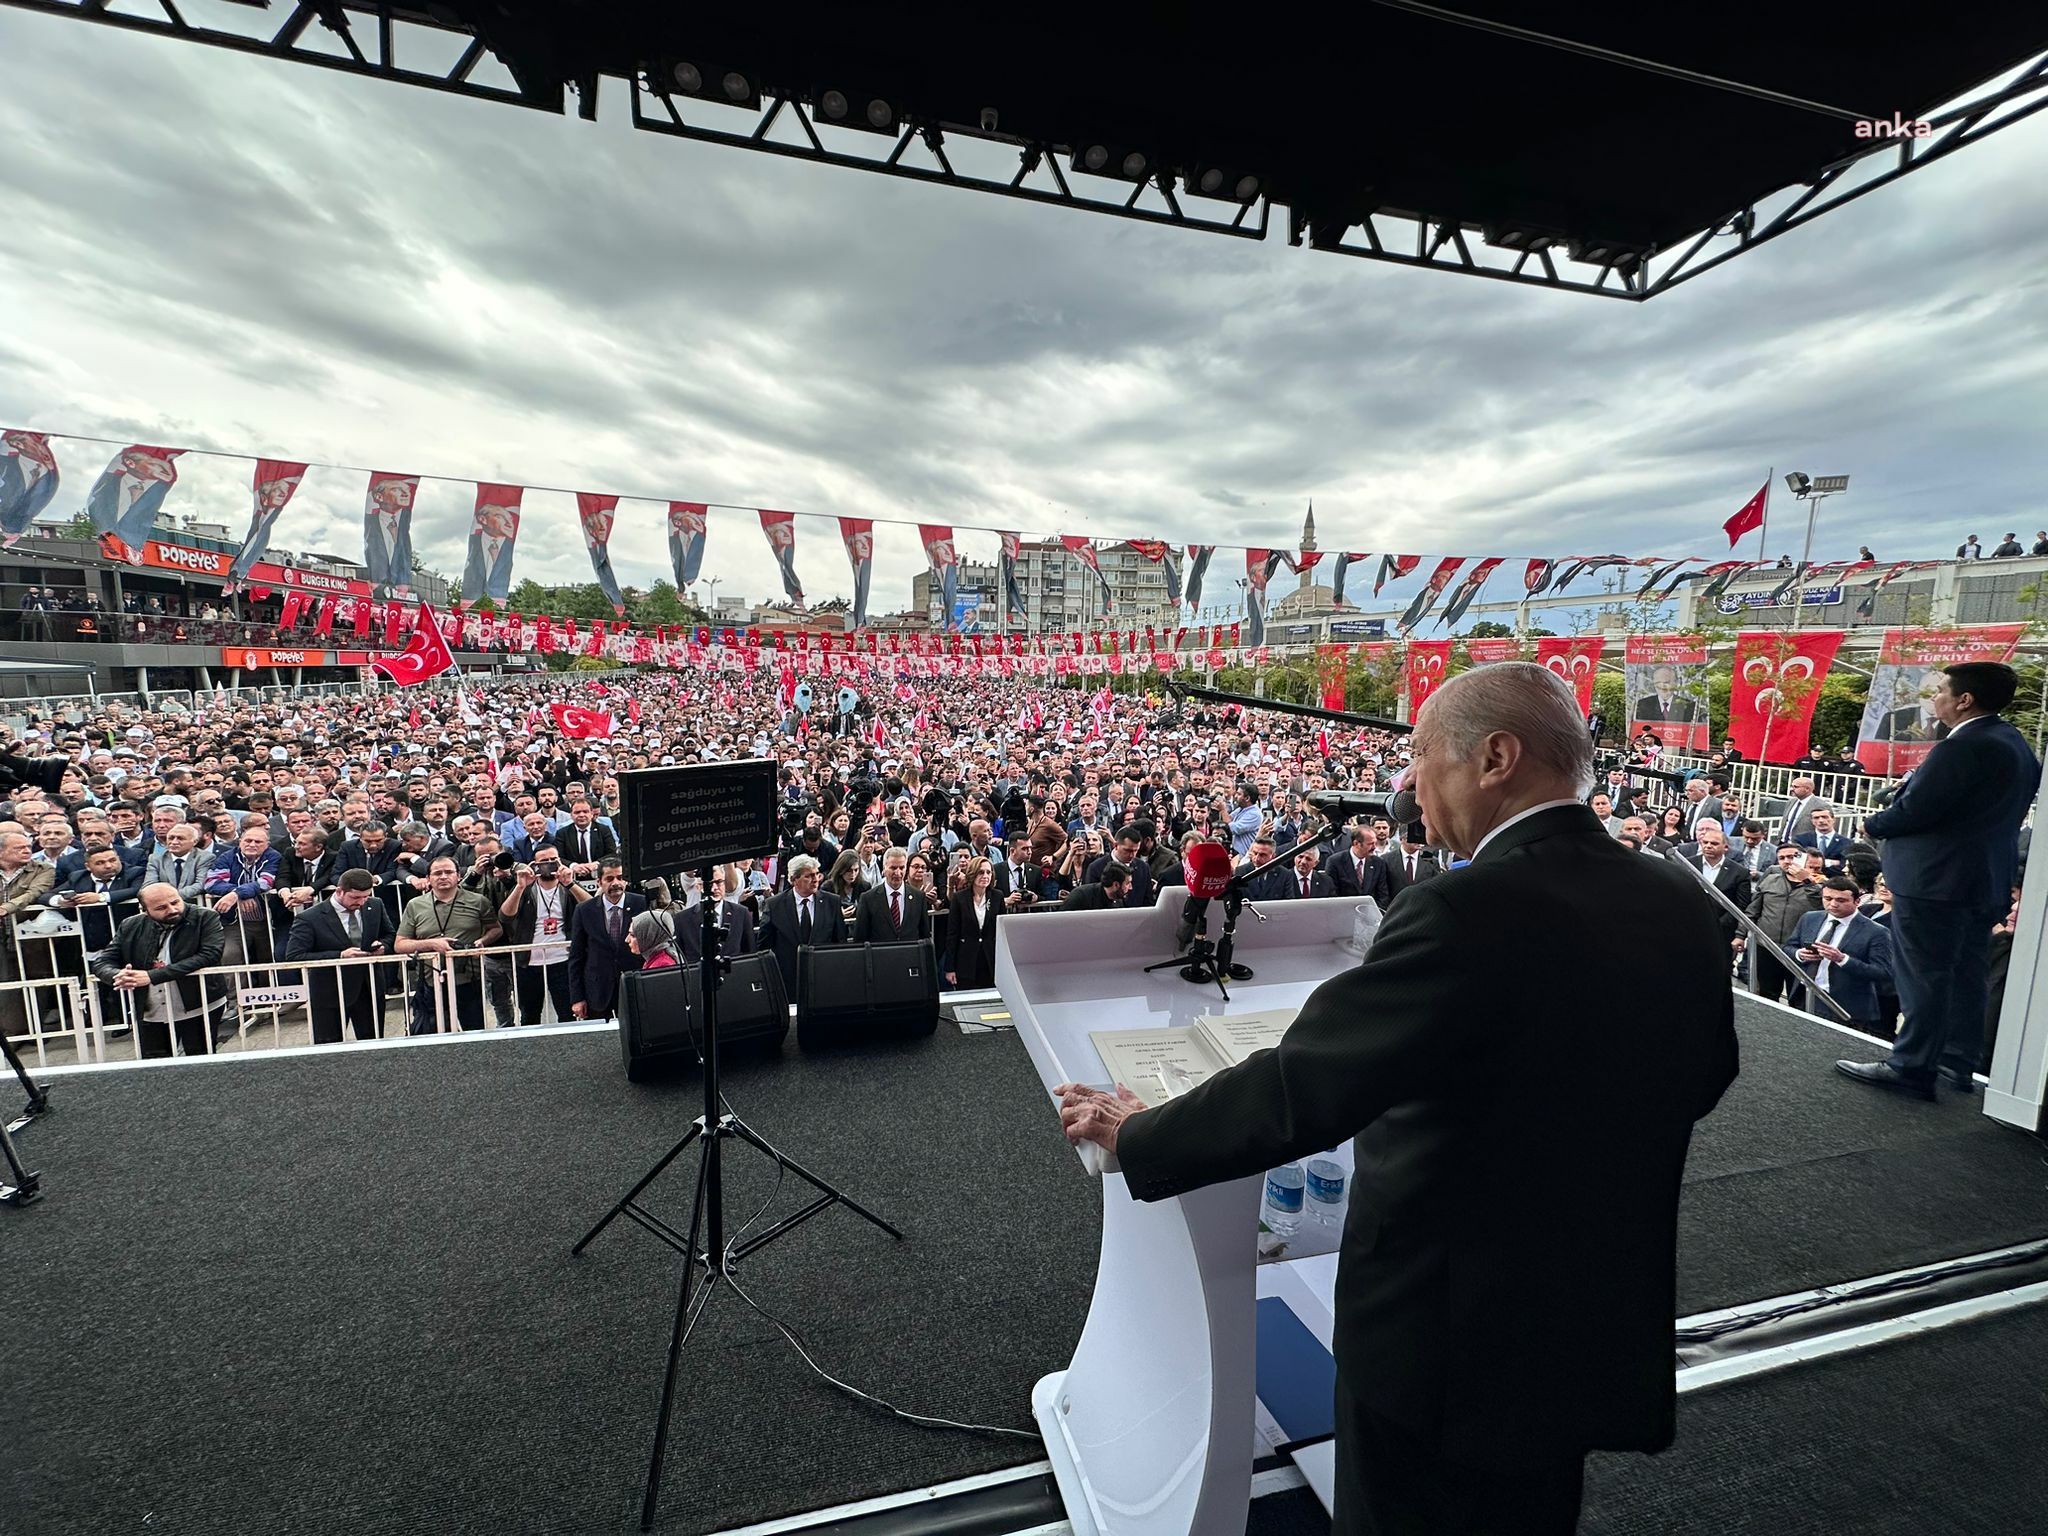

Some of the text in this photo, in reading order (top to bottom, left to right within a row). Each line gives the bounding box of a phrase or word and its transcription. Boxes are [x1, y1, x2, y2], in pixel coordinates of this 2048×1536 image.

[301, 573, 348, 591] BURGER KING
[1917, 652, 1973, 662] TÜRKİYE
[671, 788, 726, 799] sağduyu
[671, 798, 745, 815] demokratik
[657, 811, 756, 833] olgunluk içinde
[654, 824, 760, 851] gerçekleşmesini
